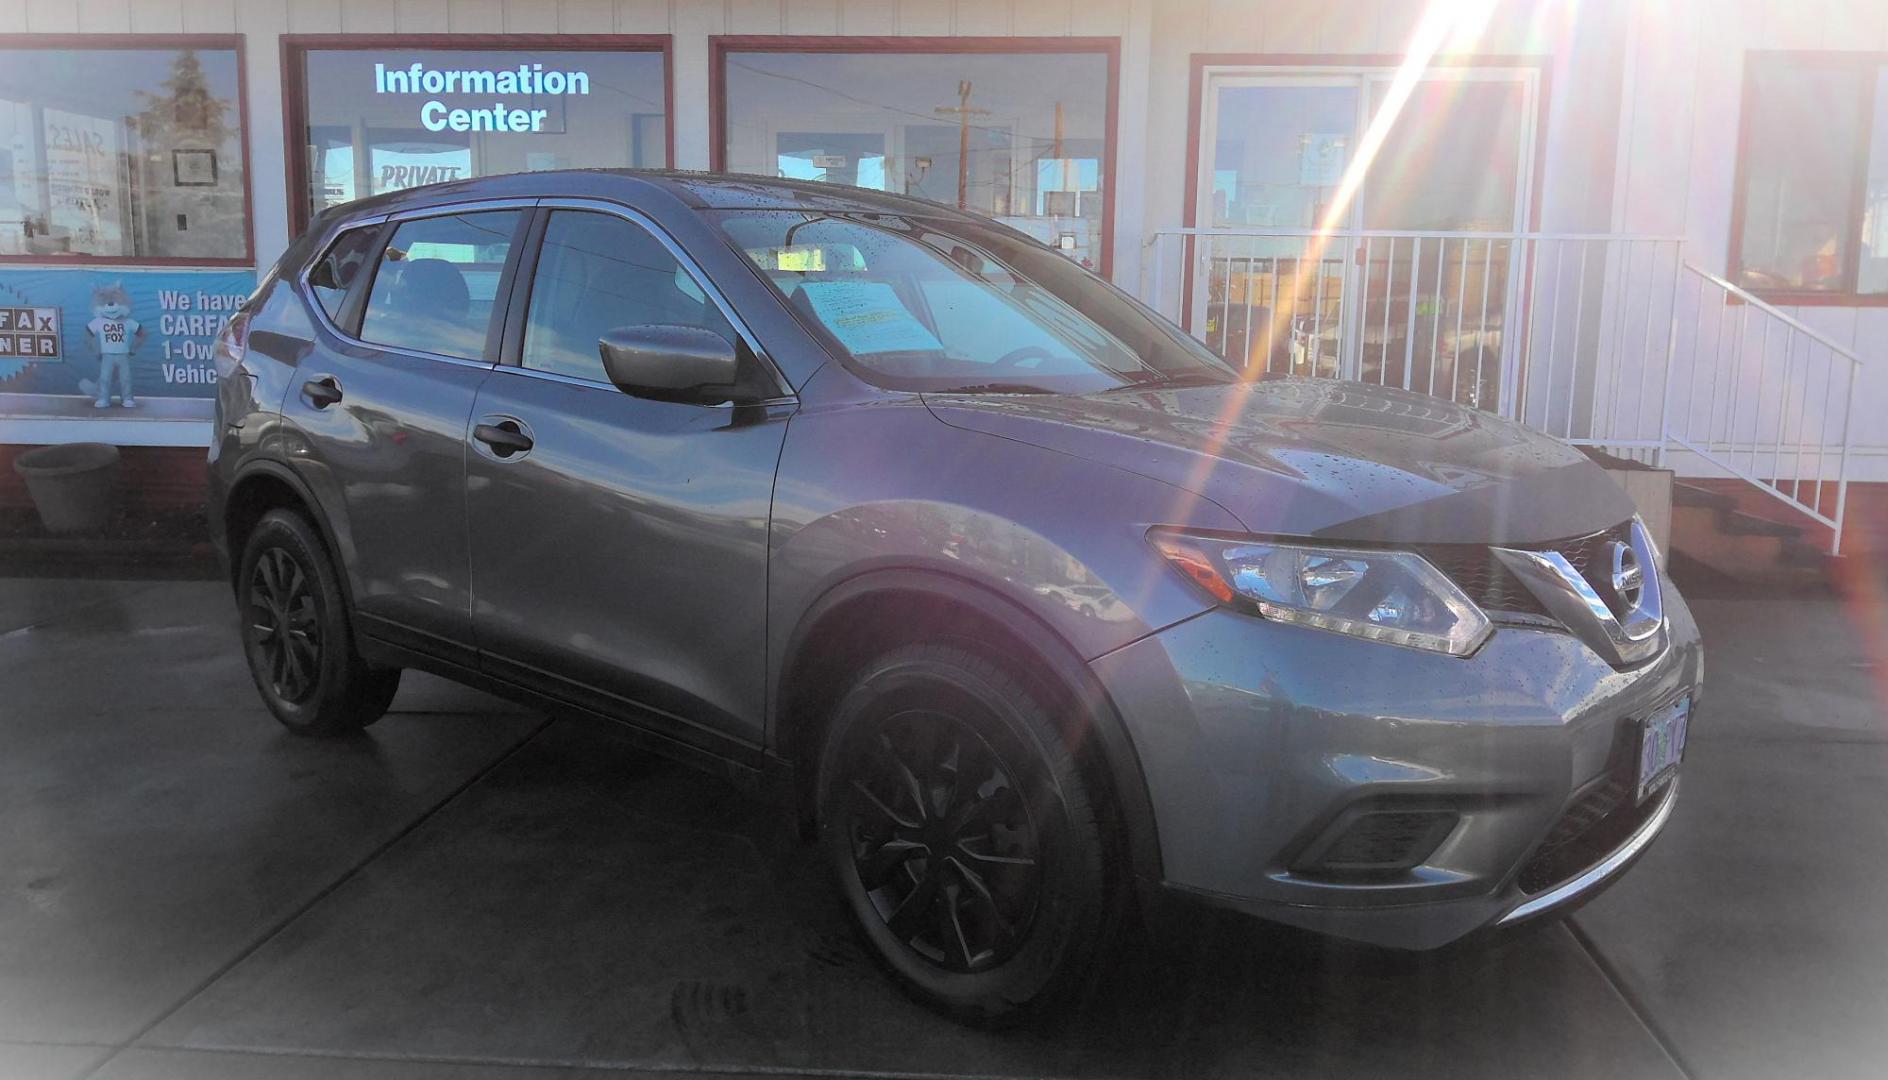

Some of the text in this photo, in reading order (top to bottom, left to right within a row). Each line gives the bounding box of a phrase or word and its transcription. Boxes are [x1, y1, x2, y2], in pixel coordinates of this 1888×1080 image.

[375, 62, 590, 95] Information
[420, 100, 548, 132] Center
[158, 290, 246, 310] We have
[103, 323, 125, 332] CAR
[104, 333, 125, 344] FOX
[161, 363, 218, 384] Vehic
